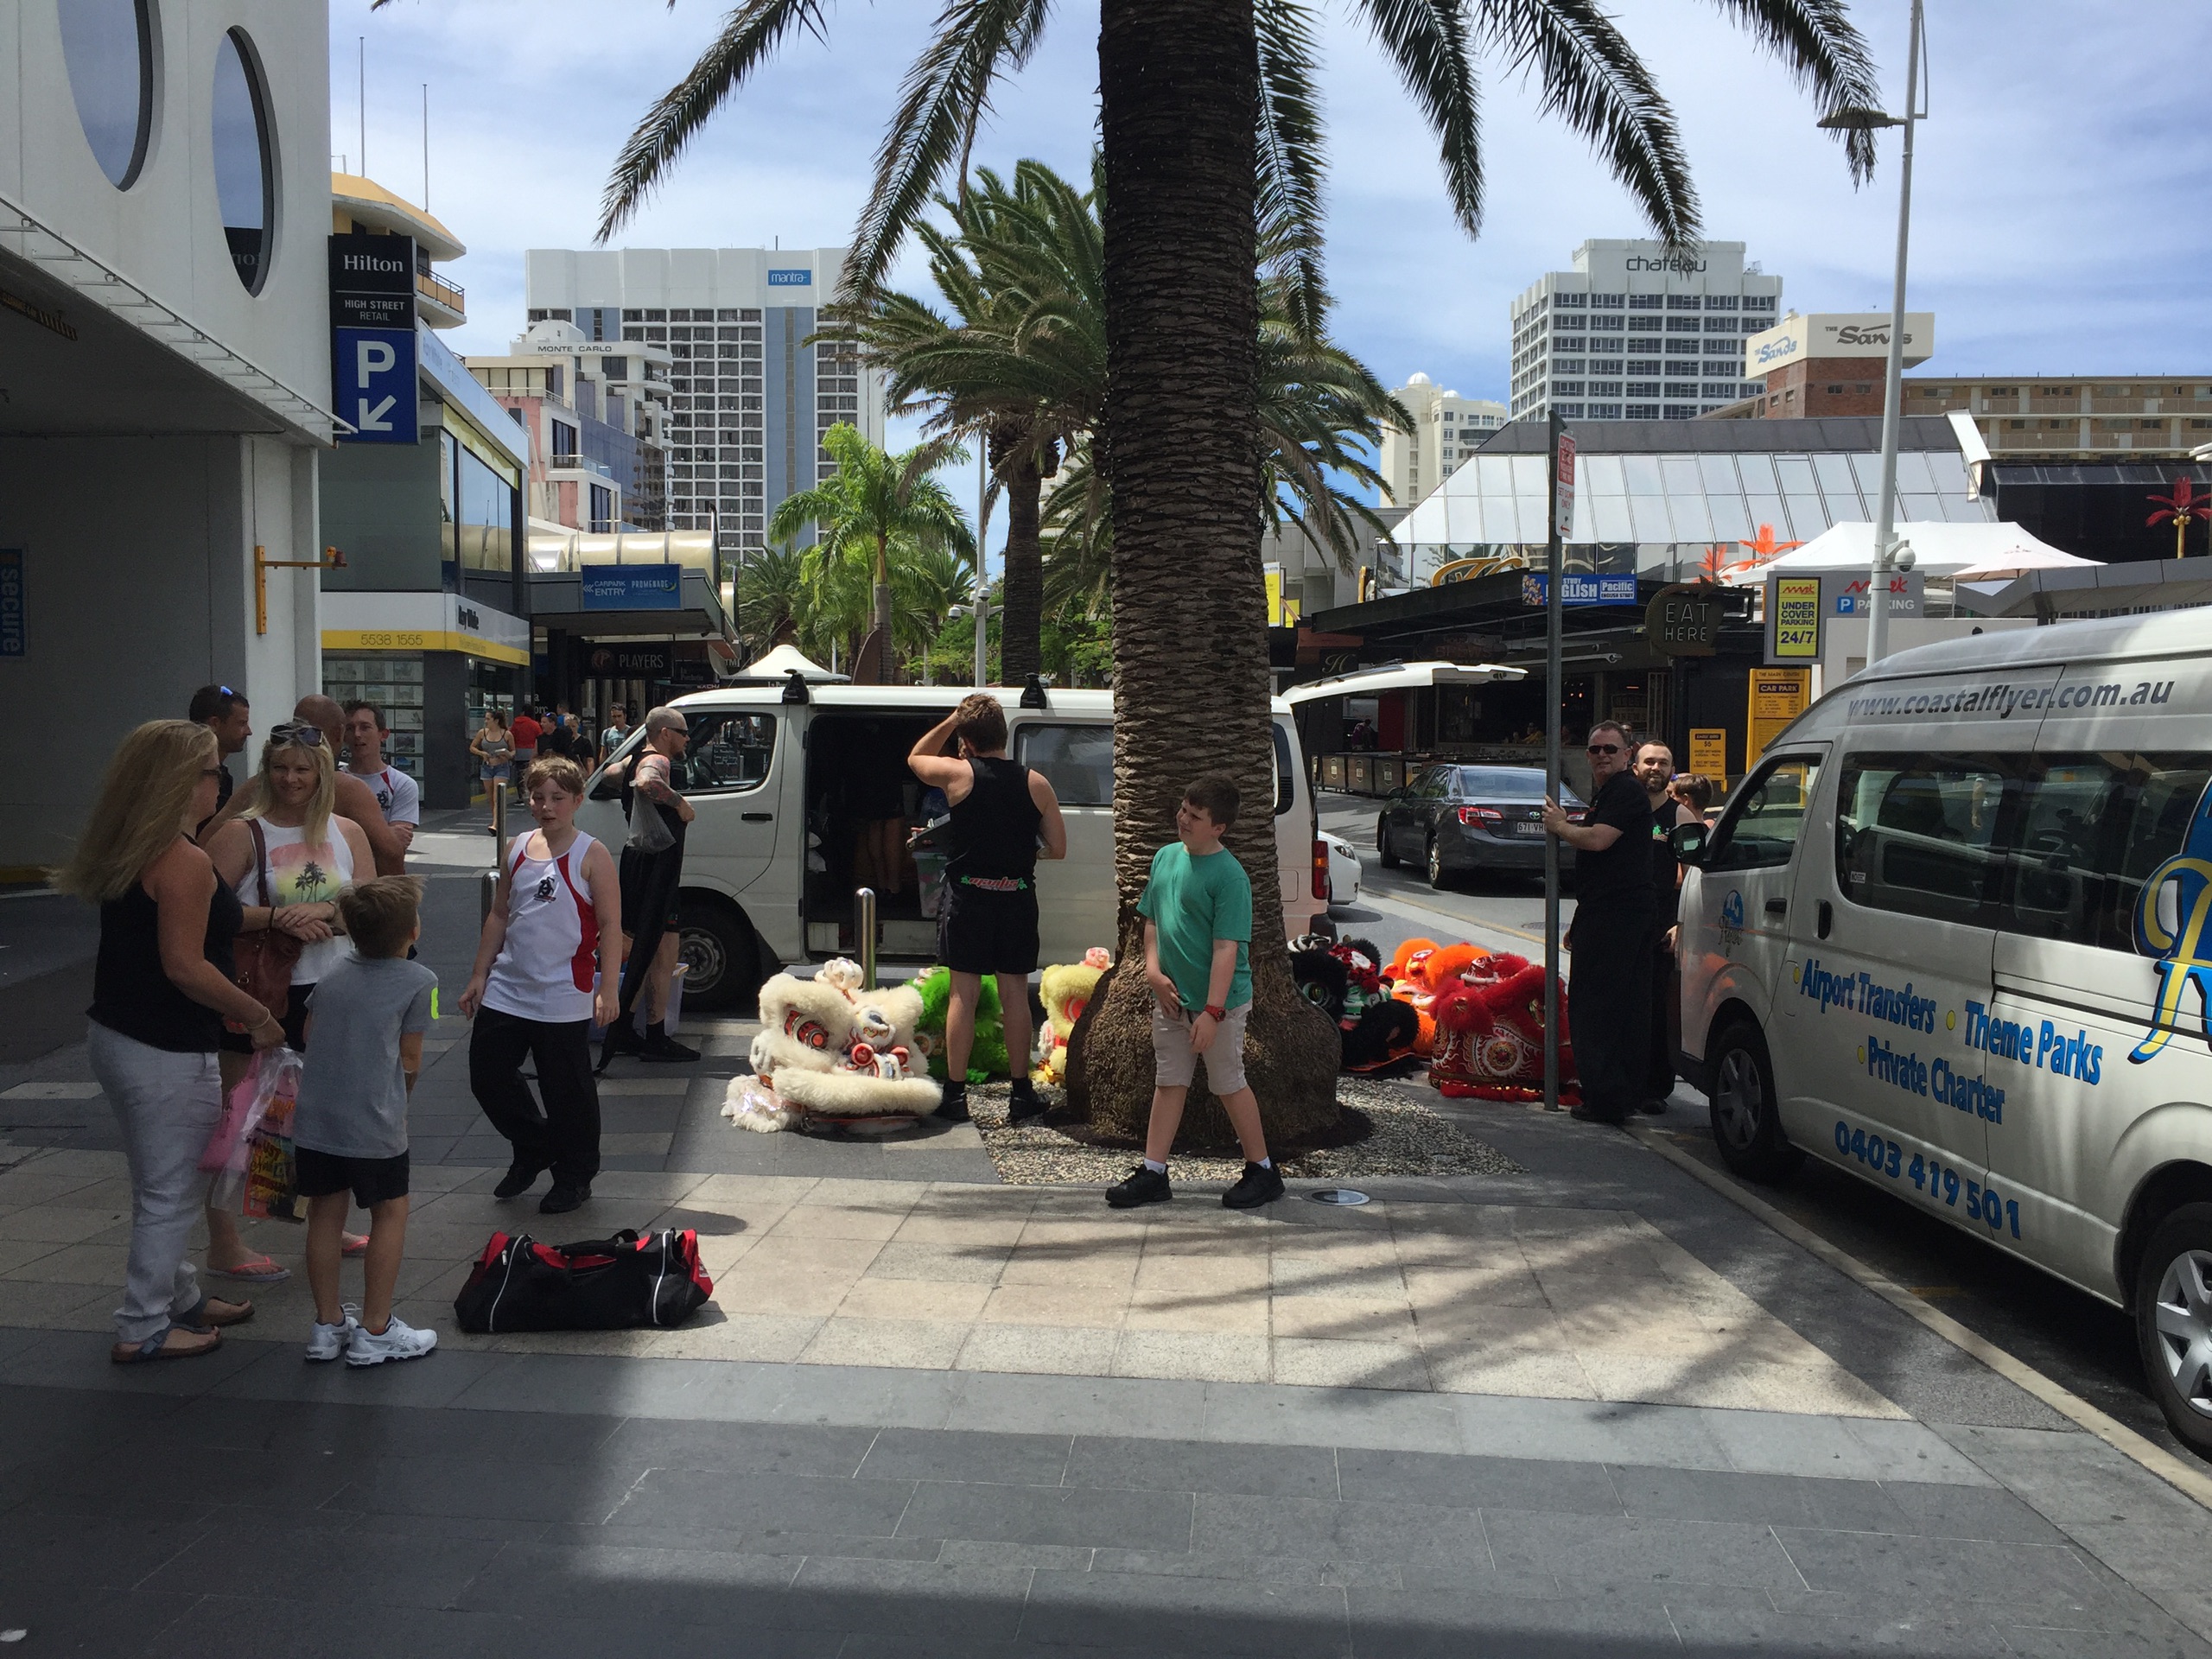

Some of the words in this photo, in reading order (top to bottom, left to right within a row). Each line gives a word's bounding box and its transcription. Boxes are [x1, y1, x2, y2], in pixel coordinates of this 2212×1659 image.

[343, 254, 404, 272] Hilton
[344, 299, 367, 309] HIGH
[369, 300, 405, 310] STREET
[359, 311, 391, 321] RETAIL
[1837, 323, 1913, 346] Sans
[357, 340, 396, 389] P
[1602, 582, 1633, 591] Pacific
[1781, 601, 1815, 610] UNDER
[1840, 598, 1851, 611] P
[1665, 602, 1710, 623] EAT
[1781, 610, 1815, 619] COVER
[360, 633, 392, 646] 5538
[396, 633, 423, 646] 1555
[1664, 626, 1707, 642] HERE
[1780, 631, 1815, 645] 24/7
[619, 654, 664, 669] PLAYERS
[1848, 680, 2176, 719] www.coastalflyer.com.au
[1799, 958, 1855, 1014] Airport
[1858, 971, 1937, 1034] Transfers
[1964, 999, 2033, 1065] Theme
[2037, 1019, 2104, 1085] Parks
[1867, 1034, 1928, 1097] Private
[1930, 1057, 2005, 1125] Charter
[1834, 1121, 1902, 1179] 0403
[1908, 1152, 1961, 1208] 419
[1966, 1178, 2022, 1242] 501
